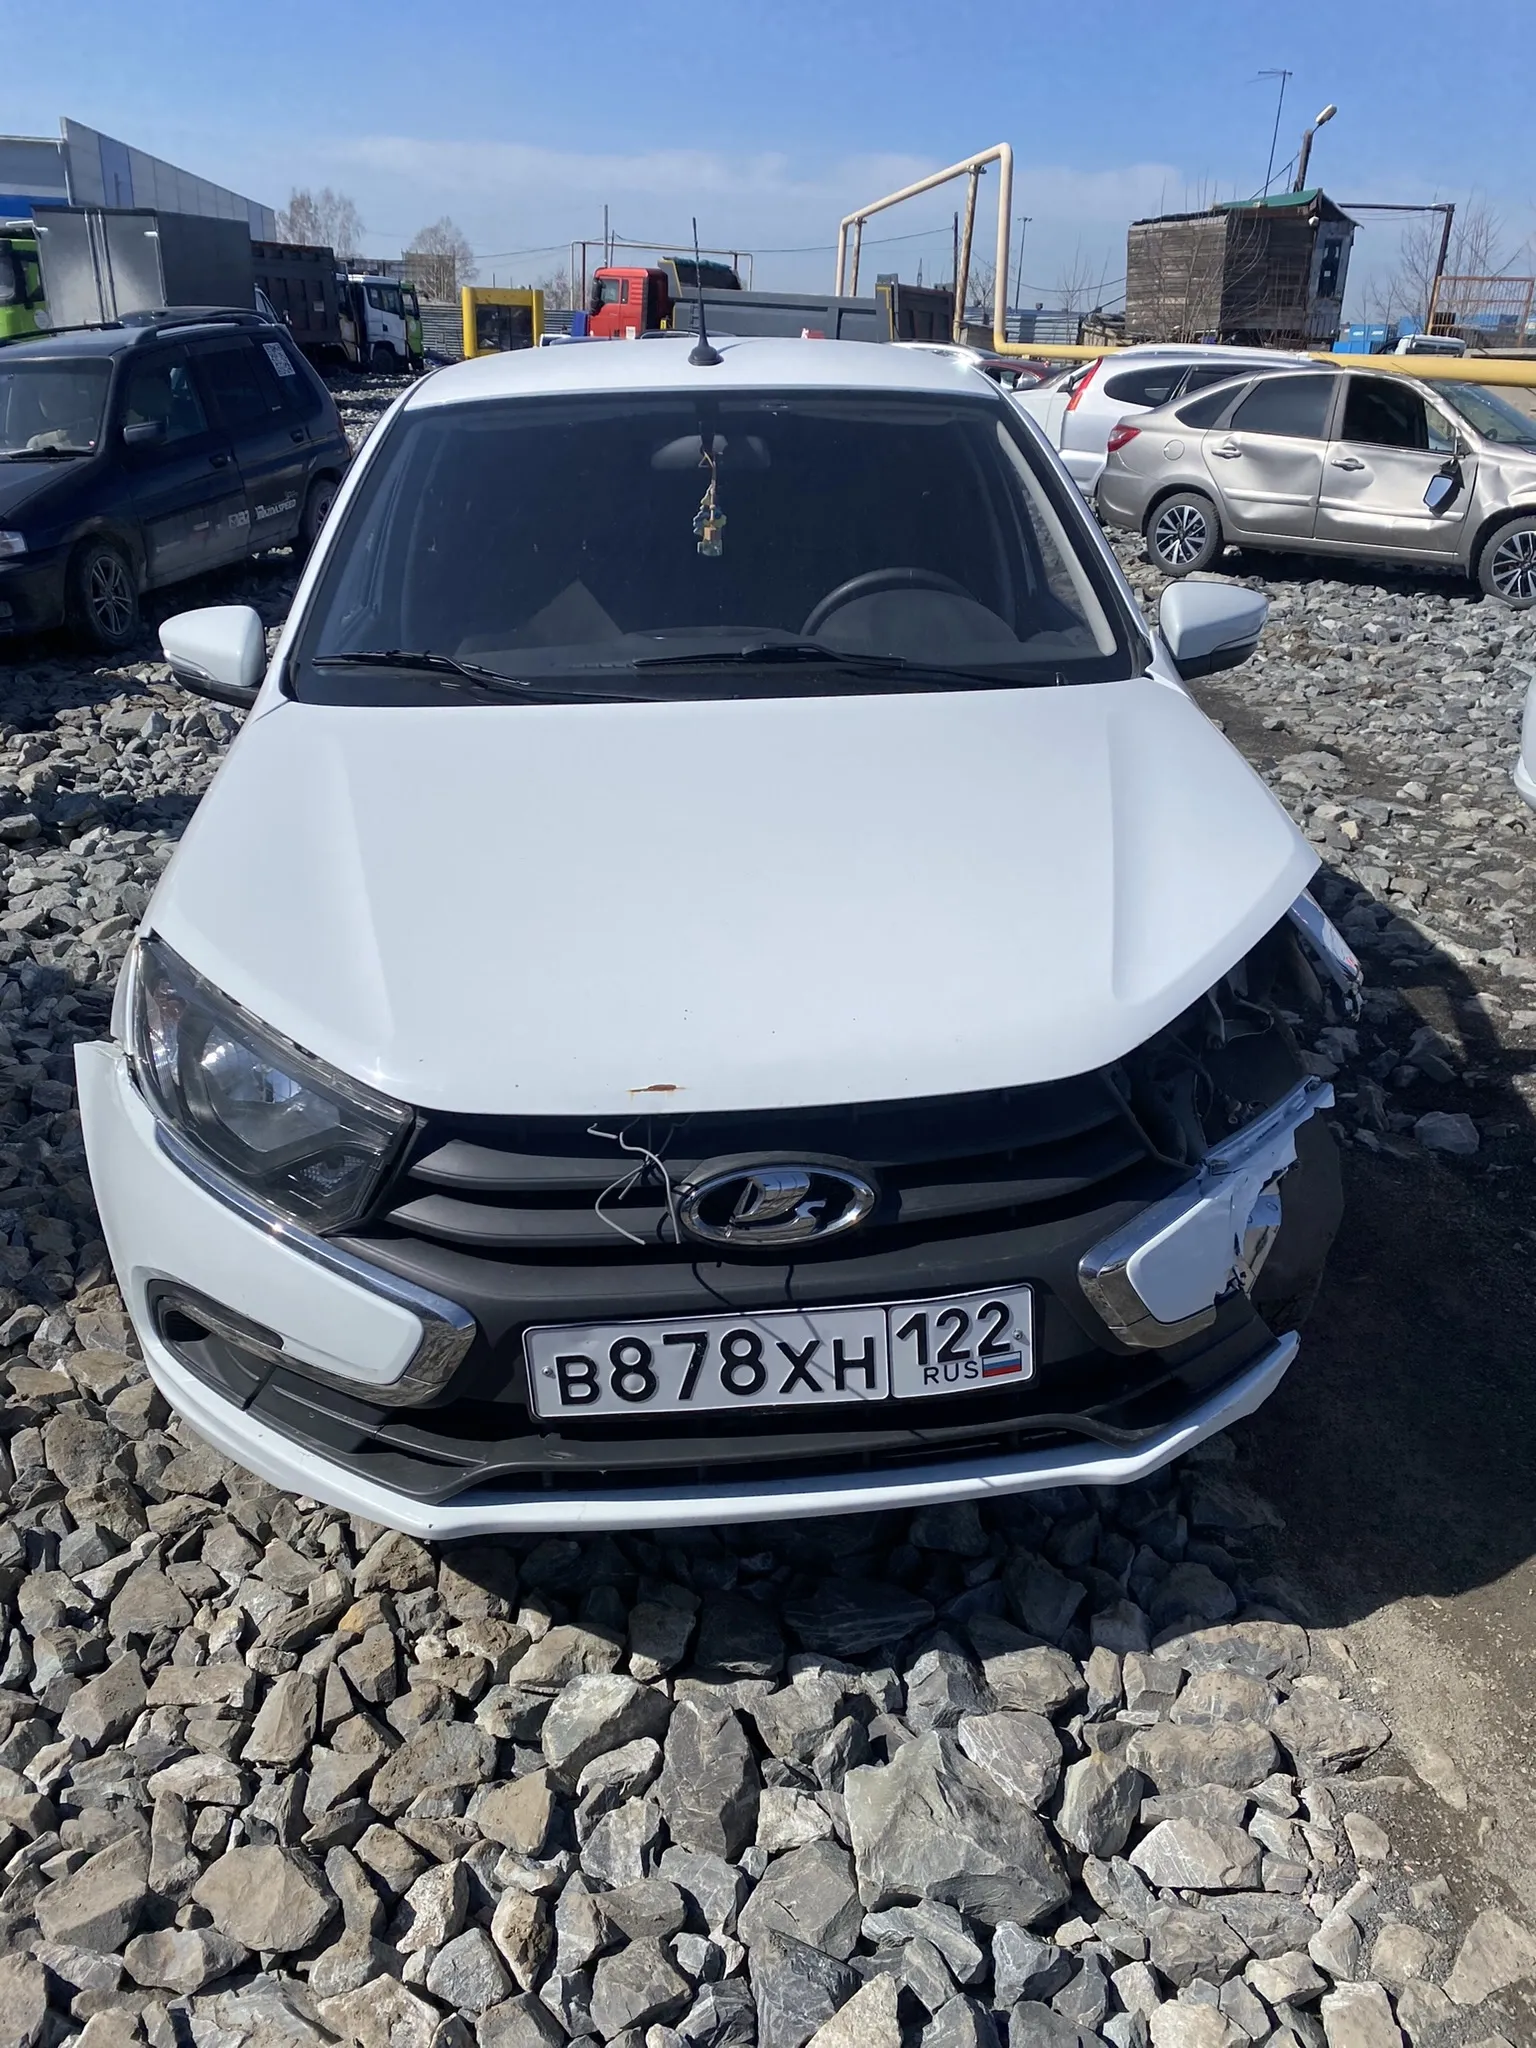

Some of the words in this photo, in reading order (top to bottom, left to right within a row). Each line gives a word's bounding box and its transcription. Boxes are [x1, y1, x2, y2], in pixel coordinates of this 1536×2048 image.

[555, 1329, 877, 1406] В878ХН
[895, 1301, 1012, 1366] 122
[923, 1360, 979, 1386] RUS
